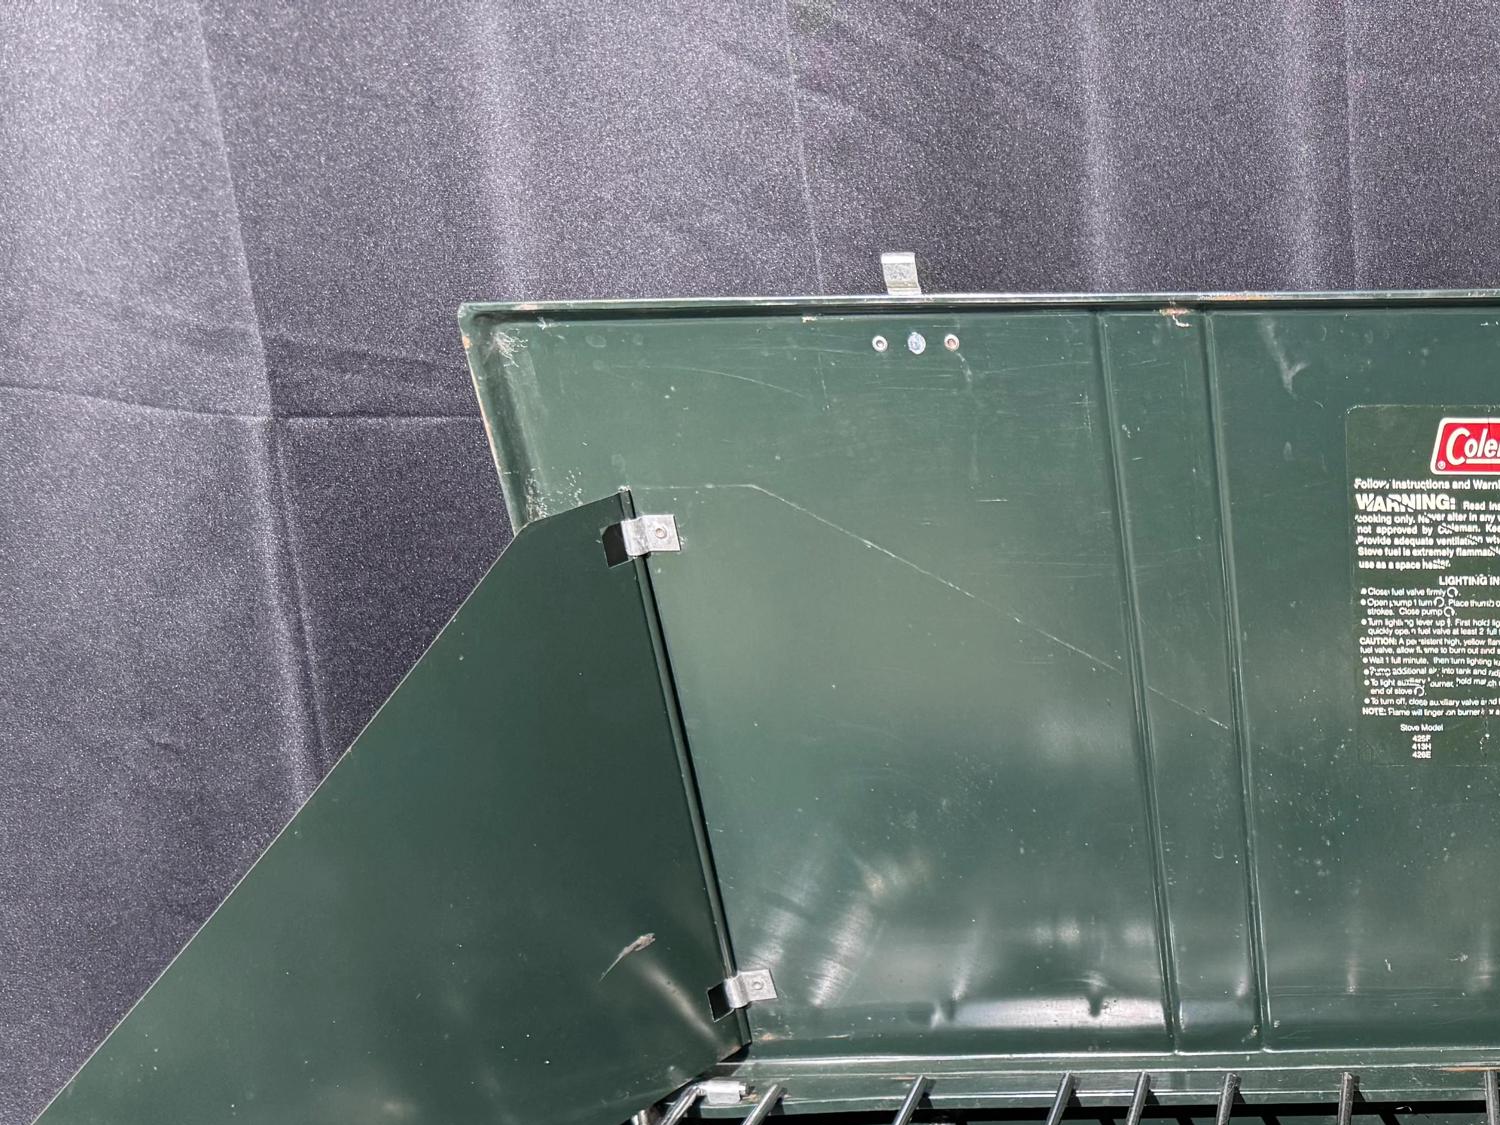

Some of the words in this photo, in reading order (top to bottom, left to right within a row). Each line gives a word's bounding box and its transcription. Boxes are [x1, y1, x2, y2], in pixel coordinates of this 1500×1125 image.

[1392, 479, 1450, 490] Instructions
[1452, 479, 1471, 490] and
[1355, 493, 1455, 512] WARNING:
[1463, 501, 1485, 511] Read
[1355, 514, 1392, 525] cooking
[1394, 514, 1415, 525] only.
[1447, 512, 1467, 522] alter
[1469, 512, 1477, 522] in
[1480, 513, 1495, 525] any
[1438, 575, 1486, 586] LIGHTING
[1400, 723, 1420, 732] Stove
[1421, 723, 1443, 732] Model
